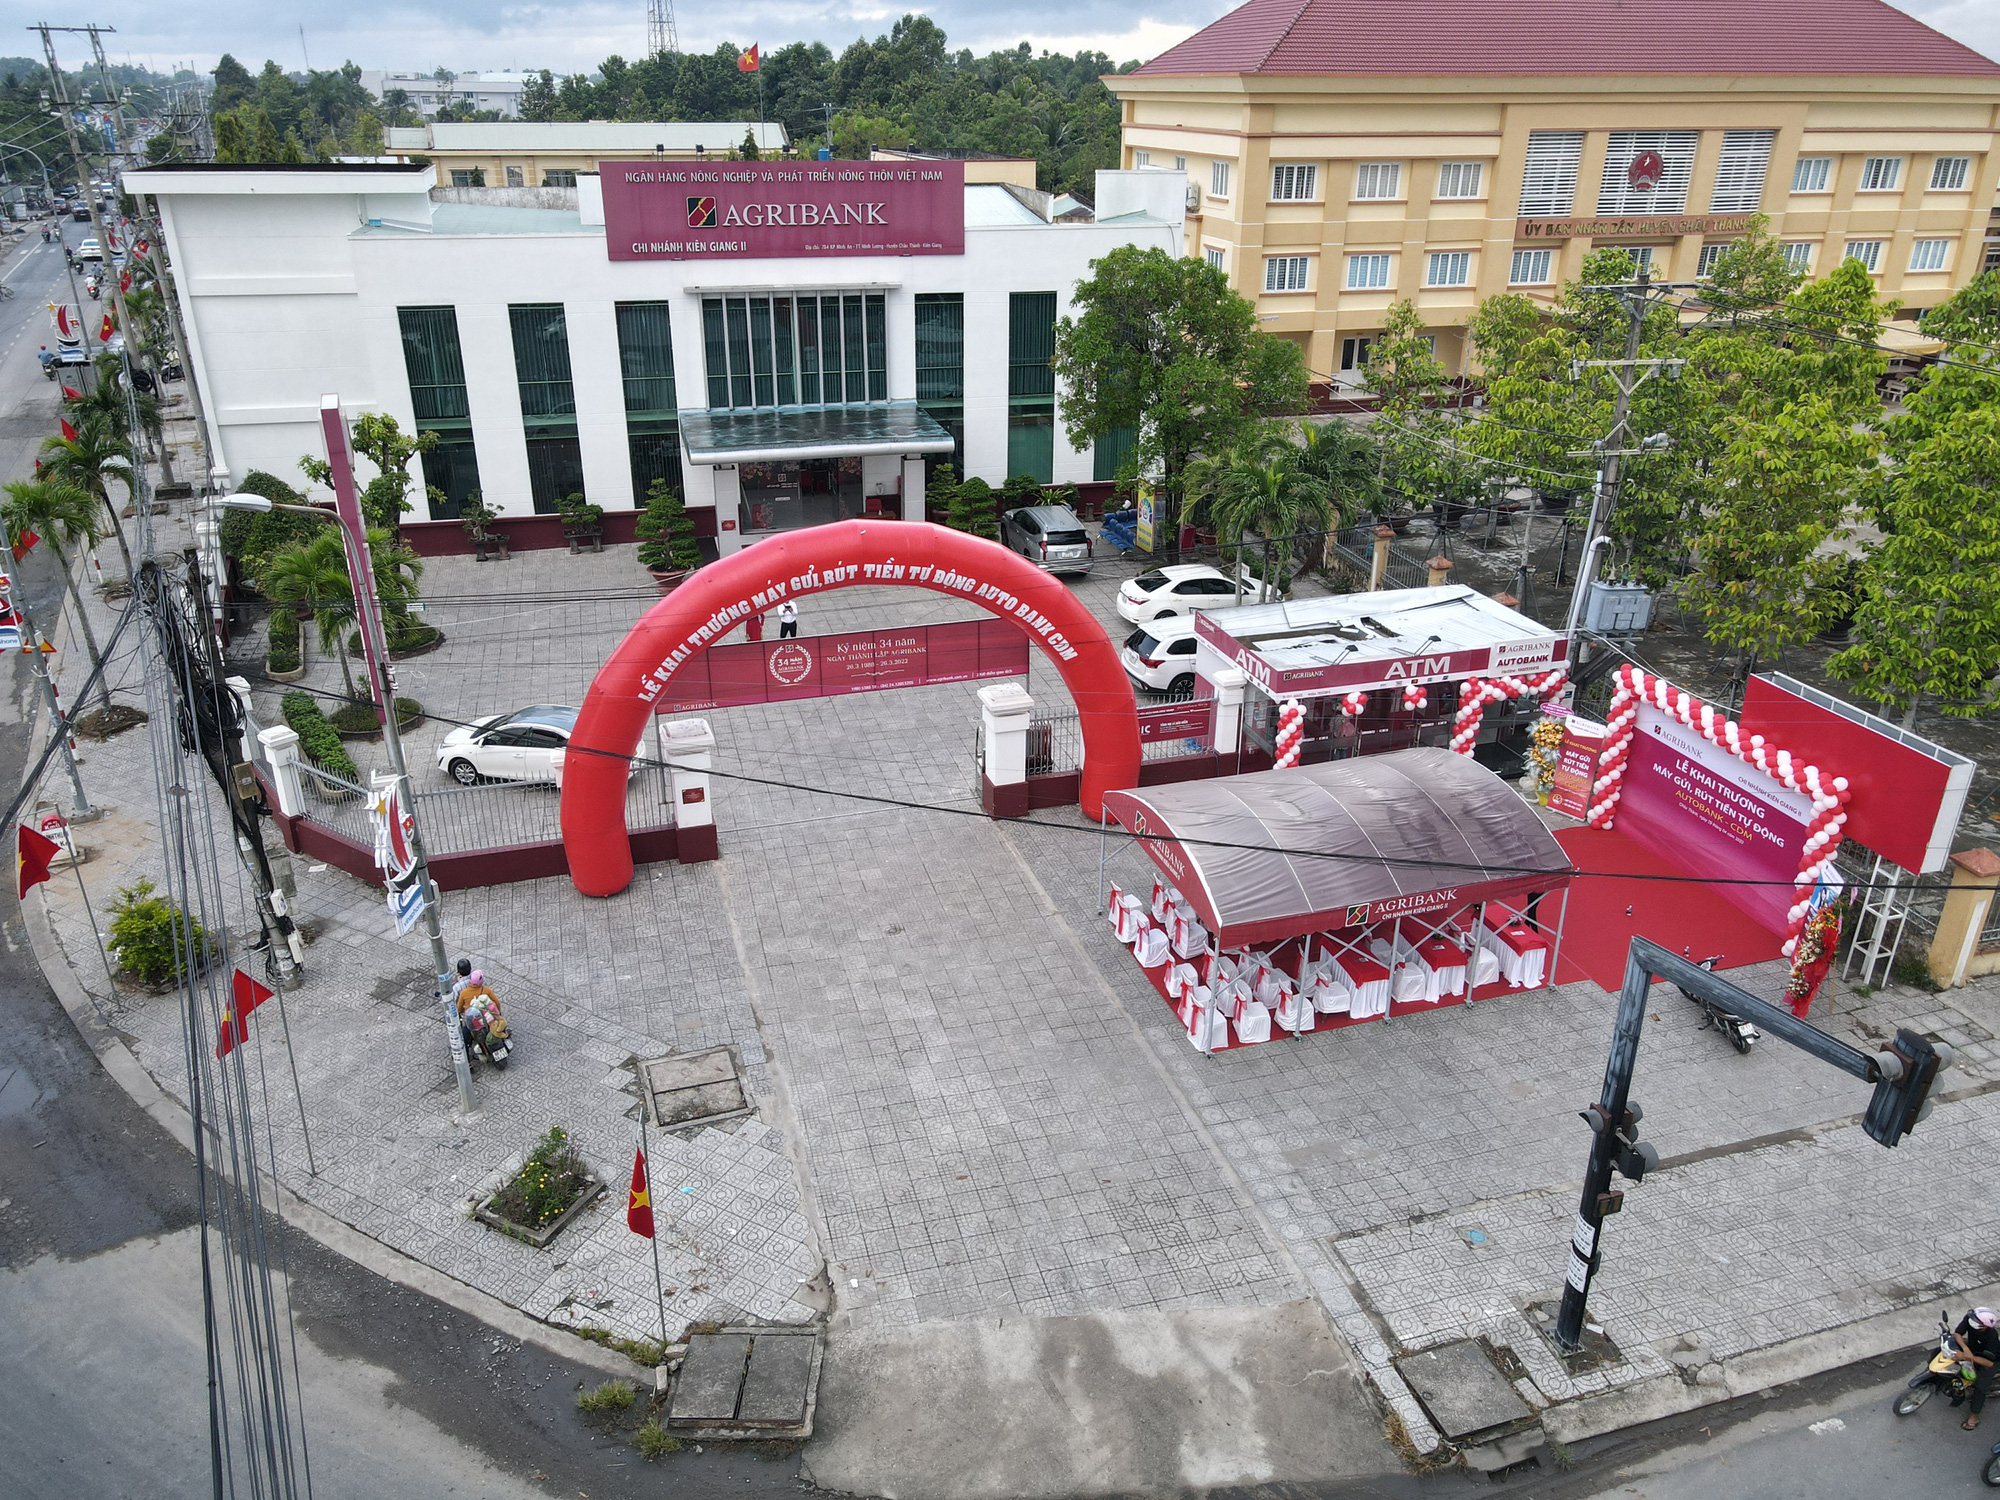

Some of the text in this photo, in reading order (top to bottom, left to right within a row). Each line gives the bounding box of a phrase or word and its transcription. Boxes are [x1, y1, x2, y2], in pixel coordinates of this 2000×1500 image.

[625, 167, 943, 185] NGÂN HÀNG NÔNG NGHIỆP VÀ PHÁT TRIỂN NÔNG THÔN VIỆT NAM
[722, 202, 889, 227] AGRIBANK
[1525, 219, 1542, 237] ỦY
[1546, 223, 1571, 236] BAN
[1574, 220, 1607, 235] NHÂN
[1610, 220, 1634, 235] DÂN
[1636, 219, 1675, 237] HUYỆN
[1677, 218, 1709, 233] CHÂU
[632, 240, 747, 253] CHI NHÁNH KIÊN GIANG II
[653, 643, 692, 682] KHAI
[687, 606, 751, 647] TRƯƠNG
[751, 579, 788, 609] MÁY
[864, 557, 905, 579] TIỀN
[909, 563, 935, 583] TỰ
[932, 569, 977, 593] ĐỘNG
[975, 583, 1019, 611] AUTO
[1014, 603, 1056, 637] BANK
[826, 653, 847, 663] NGÀY
[848, 651, 873, 662] THÀNH
[891, 646, 927, 657] AGRIBANK
[837, 637, 916, 654] Kỷ niệm 34 năm
[1506, 642, 1551, 653] AGRIBANK
[777, 657, 789, 667] 34
[1235, 648, 1271, 686] ATM
[1384, 656, 1451, 680] ATM
[1497, 654, 1549, 667] AUTOBANK
[1292, 670, 1324, 680] AGRIBANK
[682, 702, 718, 711] AGRIBANK
[1661, 731, 1703, 760] AGRIBANK
[1676, 758, 1766, 819] LỄ KHAI TRƯƠNG
[1653, 763, 1673, 780] MÁY
[1695, 786, 1716, 804] RÚT
[1753, 823, 1785, 848] ĐỘNG
[1675, 790, 1724, 824] AUTOBANK
[1730, 823, 1753, 841] CDM
[1375, 889, 1458, 914] AGRIBANK
[1392, 909, 1412, 919] NHÁNH
[1412, 907, 1426, 915] KIÊN
[1427, 904, 1444, 912] GIANG
